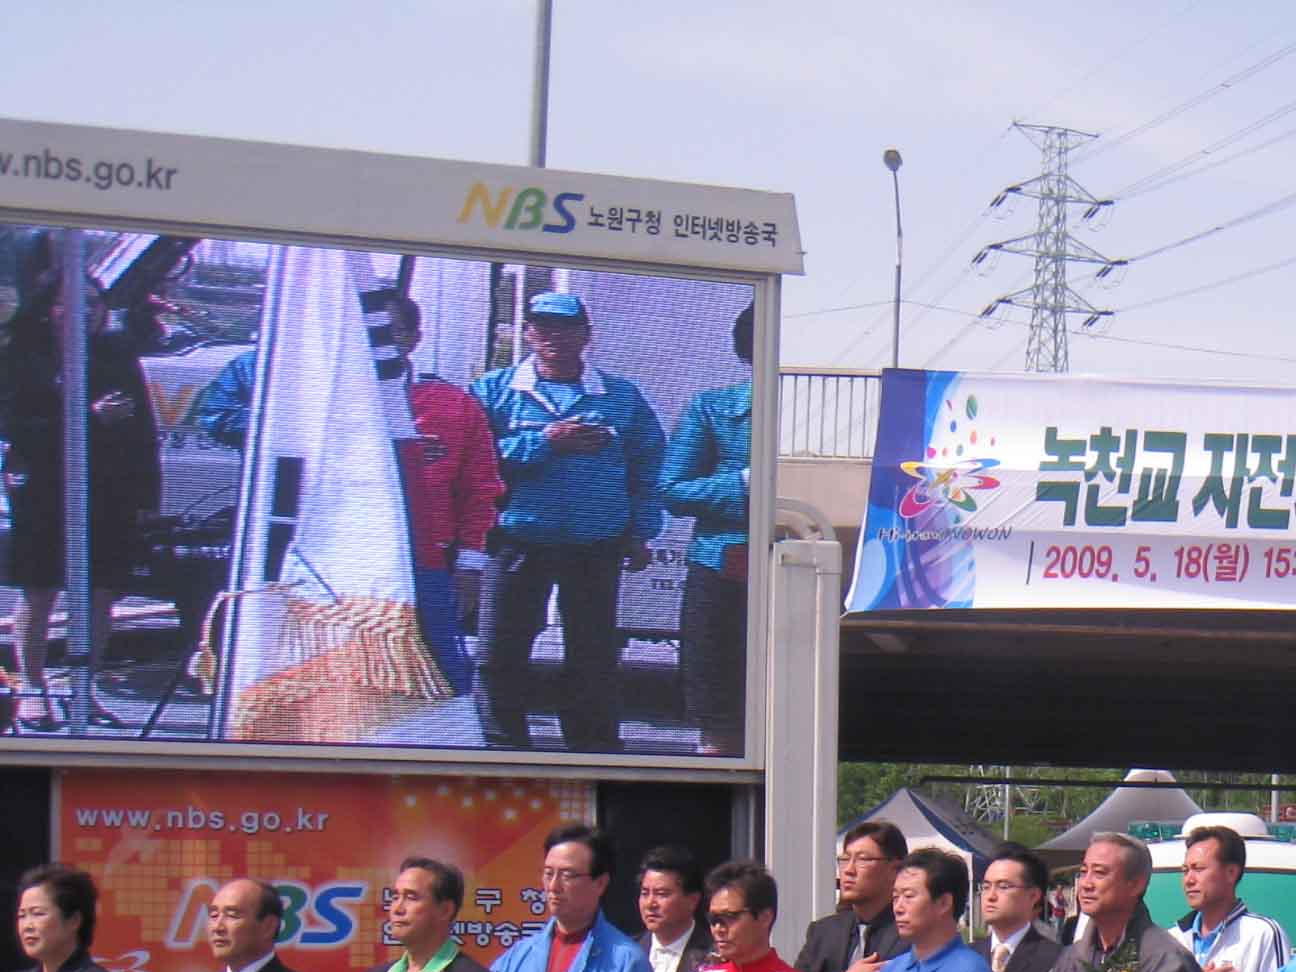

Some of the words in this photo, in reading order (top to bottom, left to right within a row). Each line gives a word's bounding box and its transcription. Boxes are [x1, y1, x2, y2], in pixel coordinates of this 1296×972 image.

[457, 180, 585, 234] NBS
[587, 206, 661, 236] 노원구청
[673, 213, 778, 248] 인터넷방송국
[1035, 426, 1187, 528] 녹천교
[1043, 544, 1120, 582] 2009.
[1134, 546, 1157, 581] 5.
[1174, 543, 1249, 582] 18(월)
[76, 804, 330, 834] www.nbs.go.kr
